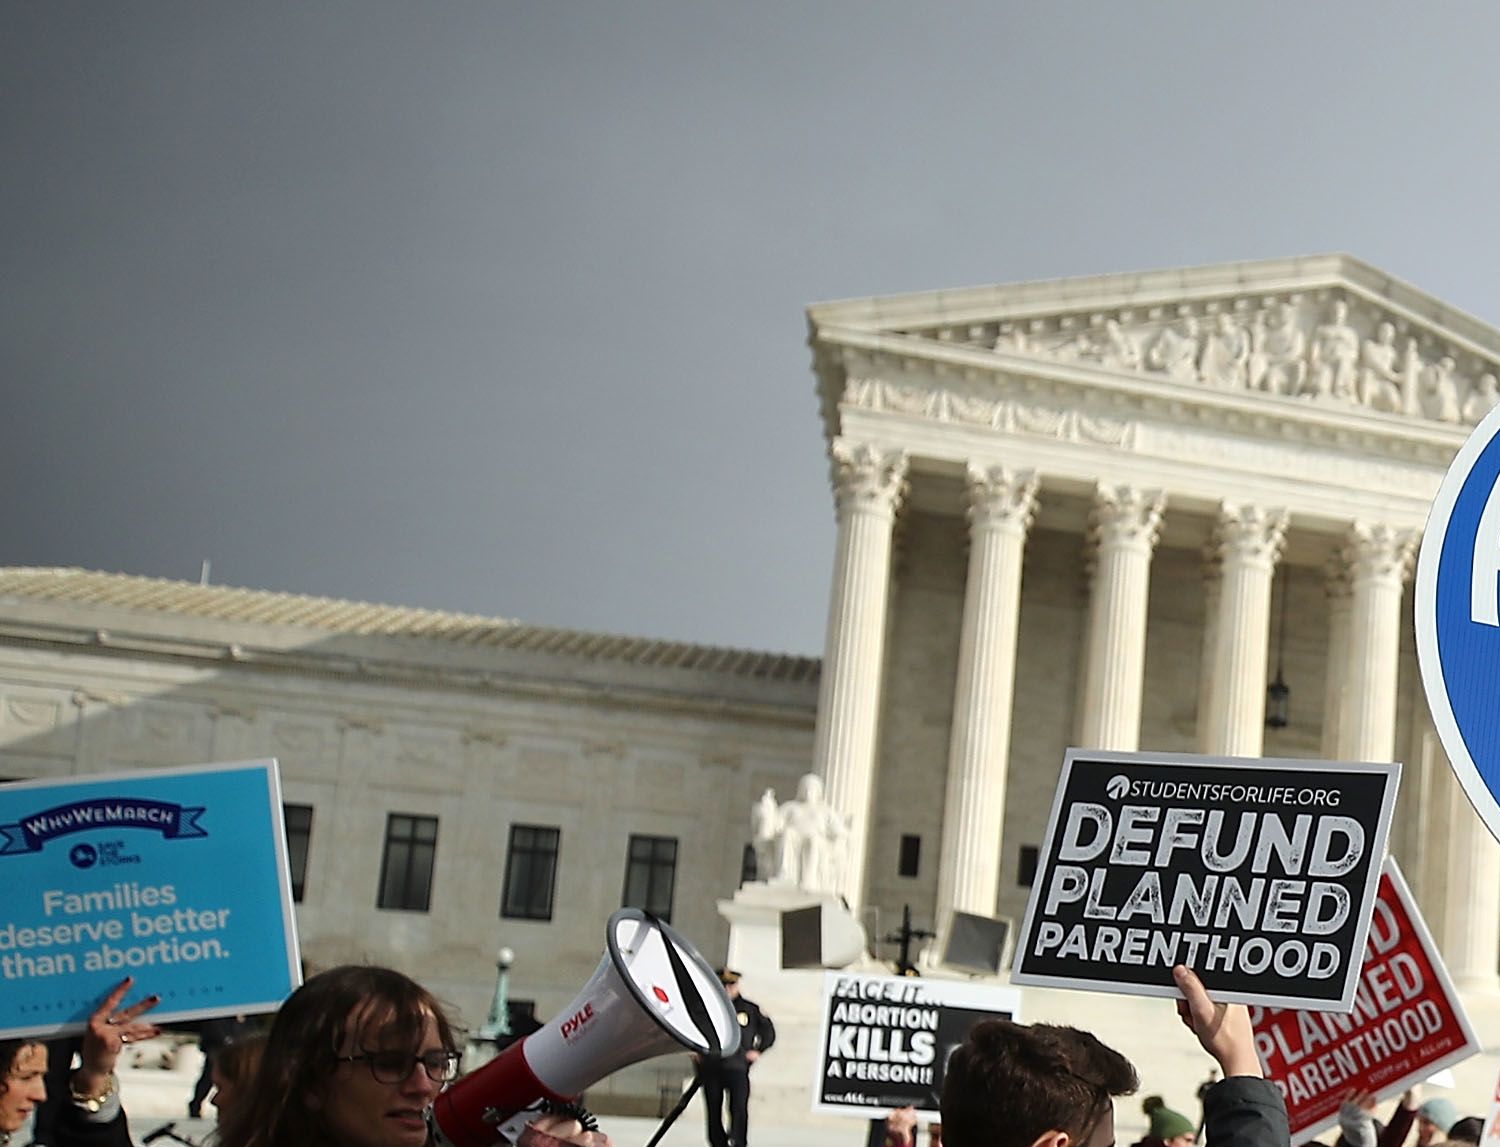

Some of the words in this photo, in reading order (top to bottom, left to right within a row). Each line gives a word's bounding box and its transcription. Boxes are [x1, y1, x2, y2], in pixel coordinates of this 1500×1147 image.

[1129, 780, 1341, 807] STUDENTSFORLIFE.ORG
[1058, 802, 1365, 878] DEFUND
[43, 882, 177, 916] Families
[1044, 866, 1351, 936] PLANNED
[0, 919, 124, 949] deserve
[132, 908, 230, 937] better
[2, 952, 76, 979] than
[84, 938, 230, 972] abortion.
[1034, 922, 1341, 980] PARENTHOOD
[561, 1001, 594, 1039] PYLE
[833, 1002, 939, 1031] ABORTION
[828, 1024, 937, 1065] KILLS
[827, 1060, 842, 1078] A
[845, 1061, 934, 1085] PERSON!!
